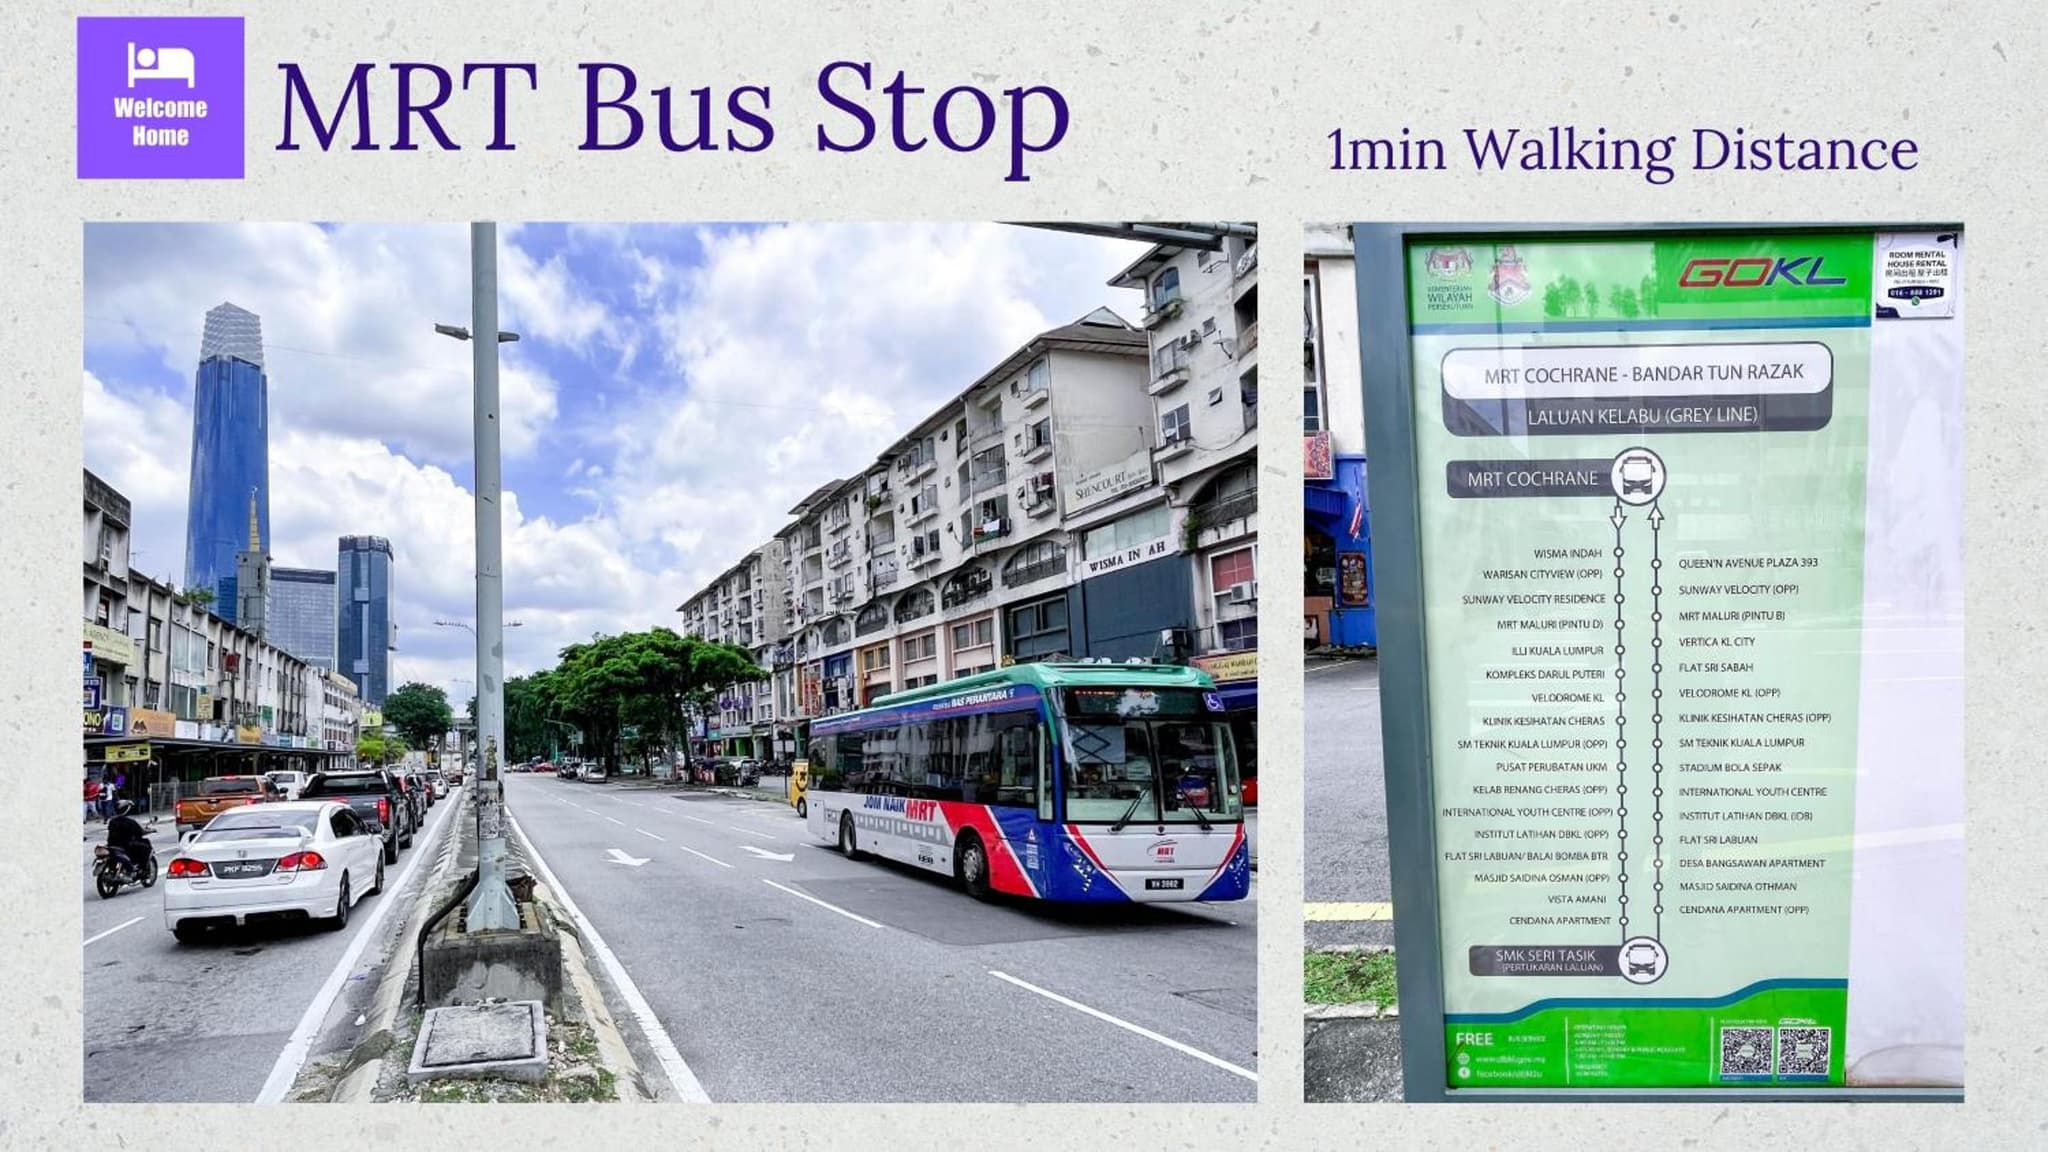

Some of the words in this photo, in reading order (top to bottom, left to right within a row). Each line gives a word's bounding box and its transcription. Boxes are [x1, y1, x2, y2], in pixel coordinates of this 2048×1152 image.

[1678, 257, 1847, 287] GOKL
[1427, 293, 1472, 302] WILAYAH
[1484, 368, 1521, 384] MRT
[1525, 366, 1618, 384] COCHRANE
[1633, 365, 1704, 383] BANDAR
[1707, 364, 1745, 381] TUN
[1747, 363, 1804, 380] RAZAK
[1528, 408, 1595, 426] LALUAN
[1597, 408, 1661, 425] KELABU
[1665, 408, 1714, 425] (GREY
[1717, 407, 1758, 424] LINE)
[1468, 472, 1502, 486] MRT
[1506, 471, 1599, 486] COCHRANE
[1534, 550, 1568, 559] WISMA
[1570, 550, 1602, 558] INDAH
[1090, 554, 1124, 572] WISMA
[1725, 558, 1764, 568] AVENUE
[1767, 558, 1798, 568] PLAZA
[1800, 558, 1818, 567] 393
[1483, 570, 1528, 579] WARISAN
[1530, 570, 1575, 579] CITYVIEW
[1577, 569, 1602, 580] (OPP)
[1679, 586, 1722, 595] SUNWAY
[1724, 585, 1770, 594] VELOCITY
[1773, 584, 1799, 595] (OPP)
[1462, 595, 1504, 604] SUNWAY
[1508, 595, 1552, 604] VELOCITY
[1554, 594, 1605, 603] RESIDENCE
[1679, 612, 1700, 621] MRT
[1702, 612, 1740, 620] MALURI
[1742, 611, 1775, 621] (PINTU
[1776, 611, 1785, 621] B)
[1497, 620, 1518, 630] MRT
[1520, 620, 1557, 629] MALURI
[1559, 620, 1591, 630] (PINTU
[1592, 620, 1603, 629] D)
[1679, 638, 1718, 646] VERTICA
[1721, 638, 1732, 646] KL
[1734, 637, 1755, 646] CITY
[1529, 647, 1561, 655] KUALA
[1564, 646, 1604, 655] LUMPUR
[1679, 663, 1703, 672] FLAT
[1704, 663, 1718, 672] SRI
[1721, 663, 1753, 672] SABAH
[1486, 671, 1536, 679] KOMPLEKS
[1538, 670, 1570, 679] DARUL
[1573, 670, 1605, 679] PUTERI
[1532, 694, 1591, 702] VELODROME
[1593, 693, 1604, 702] KL
[1679, 689, 1739, 698] VELODROME
[1741, 689, 1753, 697] KL
[1755, 688, 1781, 698] (OPP)
[952, 697, 964, 708] BAS
[1483, 717, 1512, 726] KLINIK
[1514, 717, 1566, 725] KESIHATAN
[1568, 717, 1605, 725] CHERAS
[1679, 714, 1709, 723] KLINIK
[1712, 714, 1764, 722] KESIHATAN
[1766, 713, 1803, 722] CHERAS
[1805, 713, 1831, 723] (OPP)
[1458, 740, 1472, 749] SM
[1474, 740, 1507, 749] TEKNIK
[1509, 740, 1539, 749] KUALA
[1541, 740, 1581, 748] LUMPUR
[1583, 739, 1607, 749] (OPP)
[1679, 739, 1693, 748] SM
[1696, 739, 1729, 747] TEKNIK
[1731, 738, 1762, 747] KUALA
[1765, 738, 1804, 747] LUMPUR
[1496, 763, 1526, 772] PUSAT
[1528, 763, 1583, 771] PERUBATAN
[1586, 763, 1607, 771] UKM
[1680, 763, 1722, 772] STADIUM
[1725, 763, 1750, 772] BOLA
[1752, 763, 1781, 772] SEPAK
[1473, 786, 1502, 794] KELAB
[1504, 786, 1542, 794] RENANG
[1544, 786, 1581, 794] CHERAS
[1583, 785, 1607, 794] (OPP)
[1679, 788, 1754, 796] INTERNATIONAL
[1756, 787, 1789, 796] YOUTH
[1791, 787, 1827, 796] CENTRE
[864, 796, 881, 809] JOM
[883, 798, 905, 812] NAIK
[905, 799, 936, 822] MRT
[1443, 809, 1515, 817] INTERNATIONAL
[1518, 808, 1549, 817] YOUTH
[1551, 808, 1587, 817] CENTRE
[1588, 808, 1613, 817] (OPP)
[1680, 812, 1720, 821] INSTITUT
[1722, 812, 1762, 821] LATIHAN
[1765, 812, 1788, 820] DBKL
[1474, 831, 1515, 839] INSTITUT
[1517, 830, 1556, 839] LATIHAN
[1559, 830, 1581, 839] DBKL
[1584, 830, 1609, 839] (OPP)
[1680, 836, 1702, 844] FLAT
[1703, 836, 1717, 844] SRI
[1719, 836, 1758, 844] LABUAN
[1445, 853, 1467, 861] FLAT
[1469, 853, 1482, 861] SRI
[1484, 853, 1525, 861] LABUAN/
[1680, 860, 1704, 868] DESA
[1768, 859, 1826, 867] APARTMENT
[1474, 874, 1508, 882] MASJID
[1509, 874, 1547, 882] SAIDINA
[1549, 874, 1583, 882] OSMAN
[1585, 873, 1610, 883] (OPP)
[1680, 883, 1713, 891] MASJID
[1715, 883, 1752, 891] SAIDINA
[1680, 906, 1725, 914] CENDANA
[1727, 906, 1782, 914] APARTMENT
[1784, 905, 1809, 915] (OPP)
[1509, 917, 1555, 925] CENDANA
[1556, 917, 1611, 925] APARTMENT
[1496, 950, 1525, 962] SMK
[1528, 950, 1555, 962] SERI
[1559, 950, 1596, 961] TASIK
[1502, 963, 1563, 973] (PERTUKARAN
[1564, 963, 1604, 972] LALUAN)
[1456, 1033, 1494, 1045] FREE
